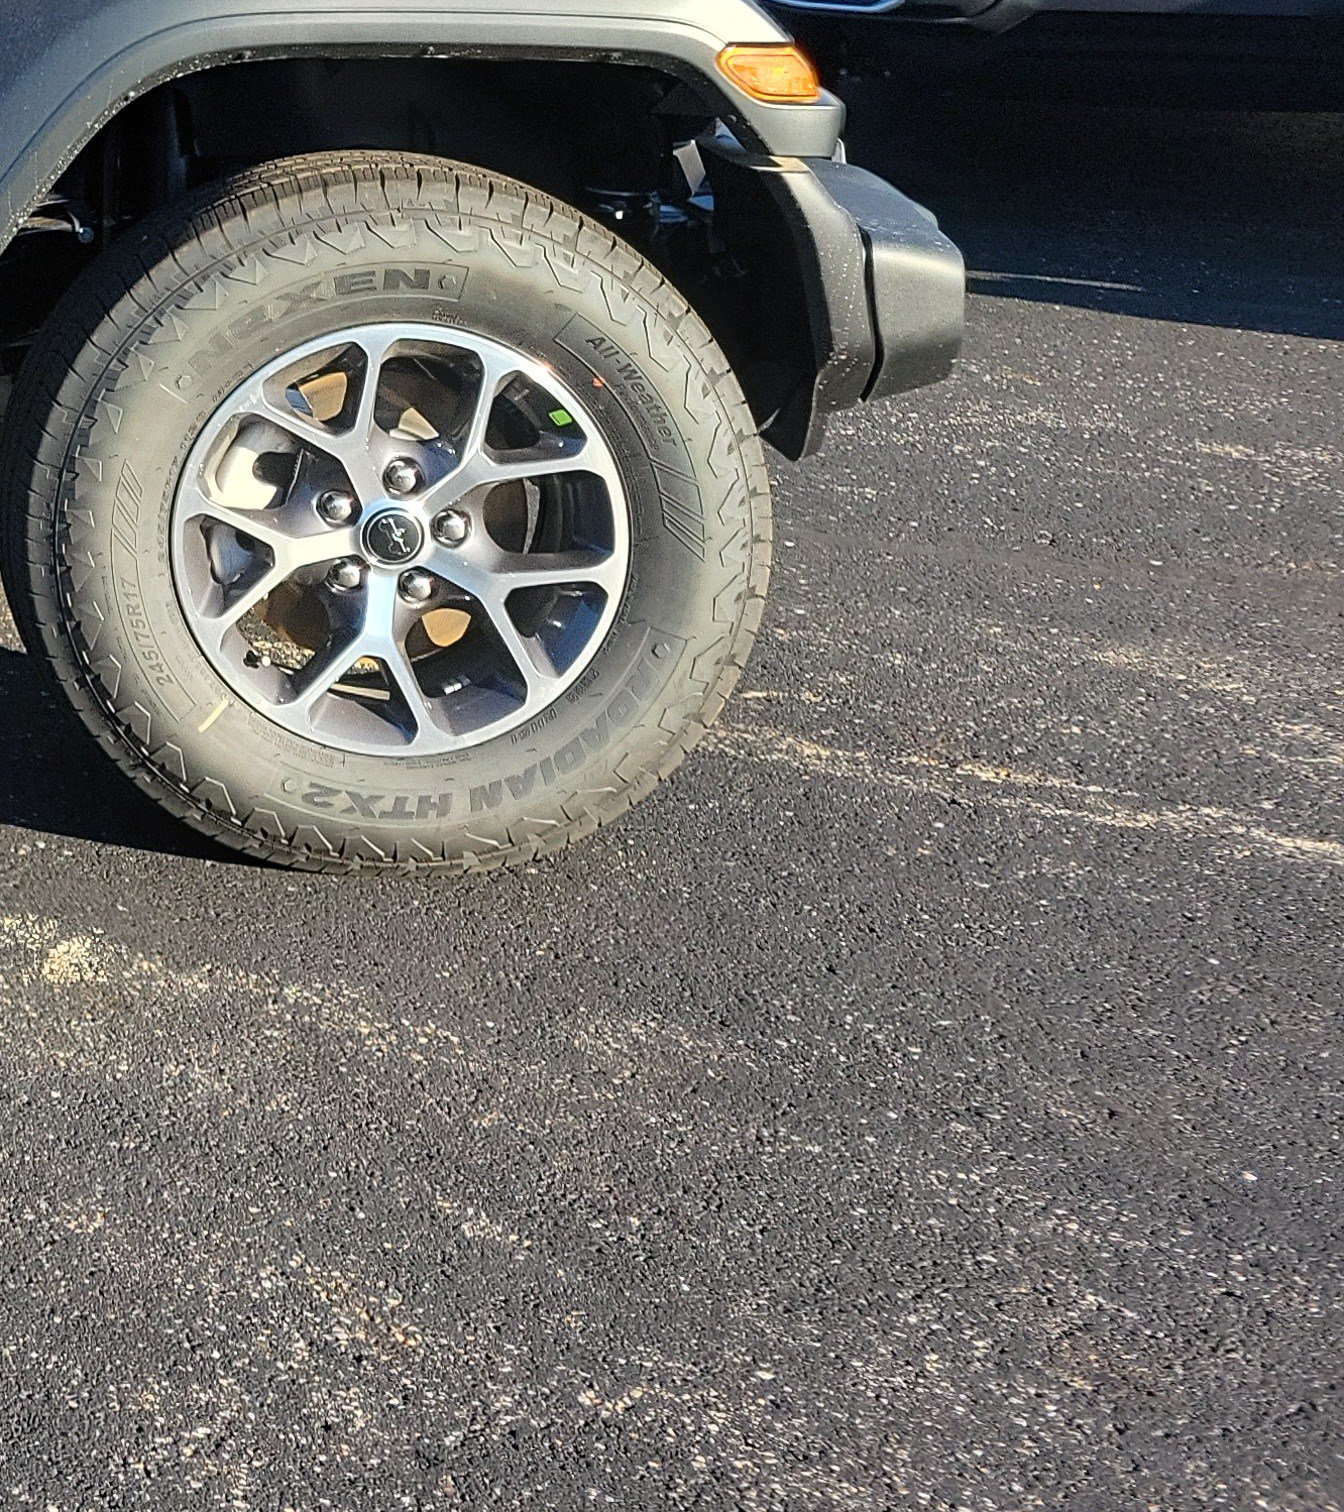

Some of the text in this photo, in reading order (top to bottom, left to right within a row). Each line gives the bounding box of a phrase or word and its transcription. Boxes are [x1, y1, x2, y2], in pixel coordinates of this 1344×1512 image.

[584, 336, 678, 447] All-Weather
[119, 577, 175, 687] 245/75R17
[468, 651, 666, 814] ROADIAN
[299, 779, 455, 821] HTX2
